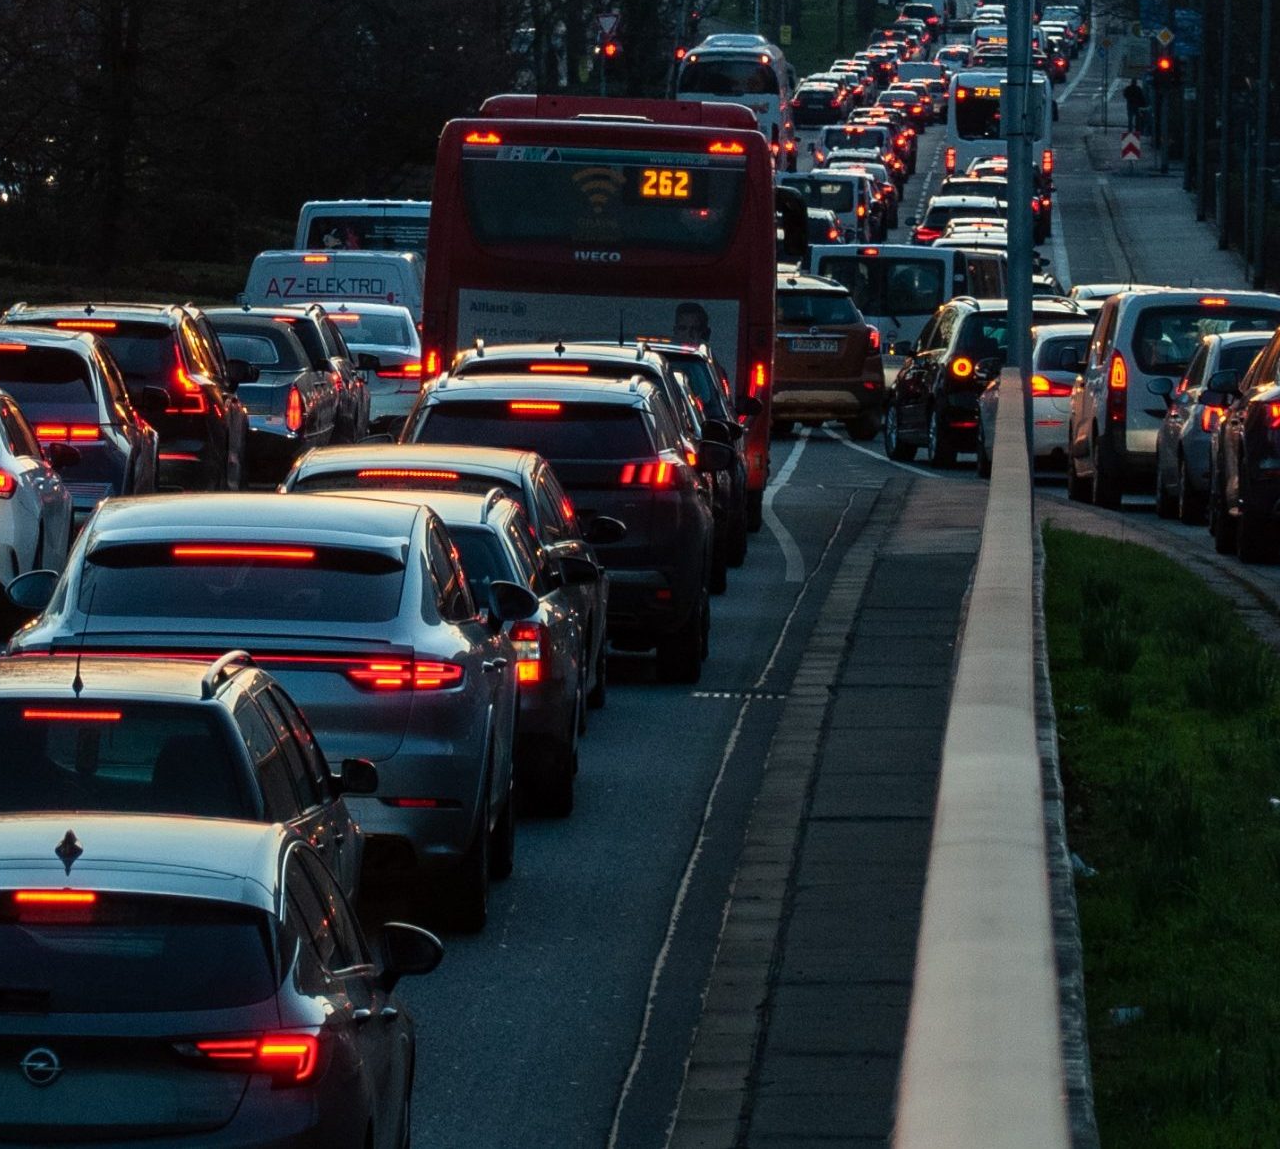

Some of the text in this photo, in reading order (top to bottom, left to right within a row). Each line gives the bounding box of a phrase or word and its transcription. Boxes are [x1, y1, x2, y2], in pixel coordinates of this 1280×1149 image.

[642, 169, 689, 198] 262
[573, 250, 621, 263] IVECO
[265, 277, 383, 299] AZ-ELEKTRO
[470, 302, 509, 314] Allianz
